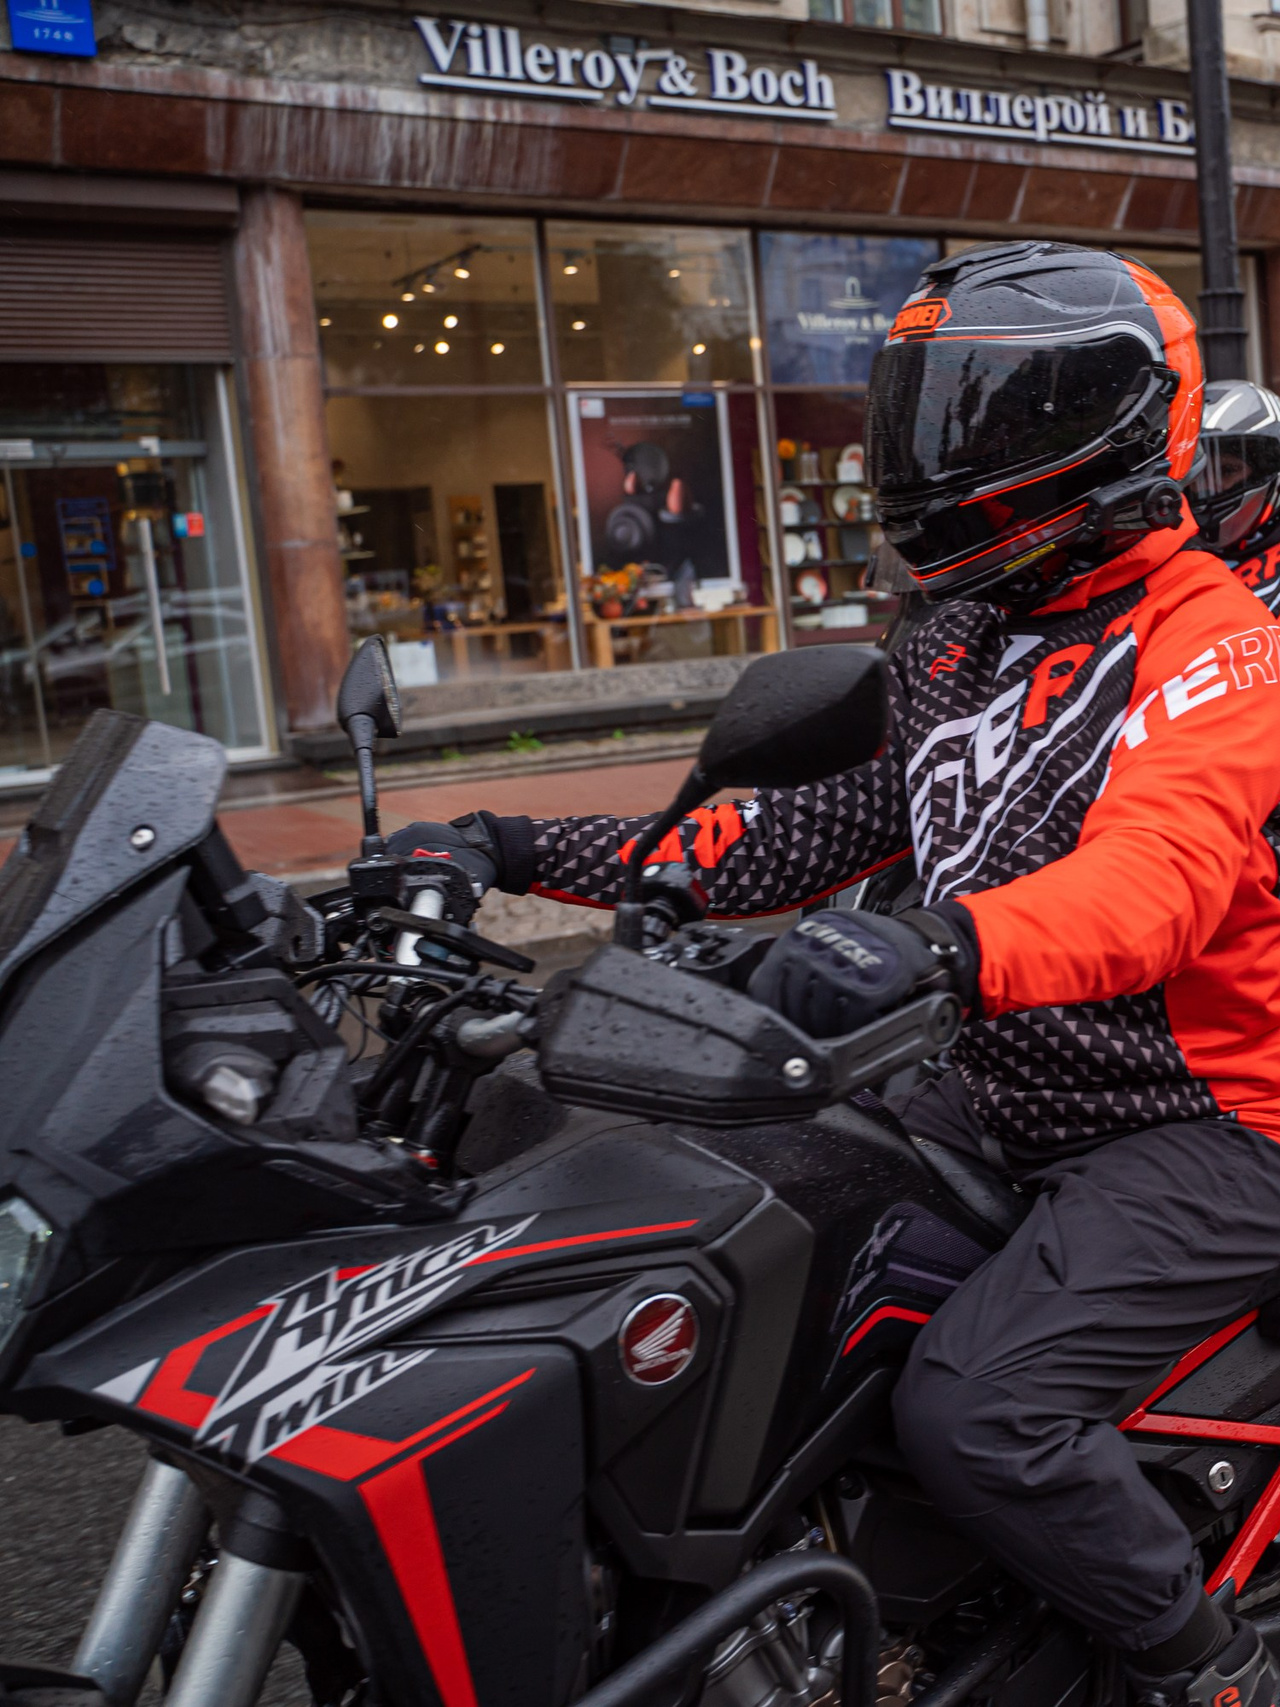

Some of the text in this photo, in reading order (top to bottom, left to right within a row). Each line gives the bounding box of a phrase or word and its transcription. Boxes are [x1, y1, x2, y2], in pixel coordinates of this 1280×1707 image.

[413, 16, 838, 110] Villeroy & Boch
[885, 68, 1112, 142] Виллерой
[1119, 105, 1149, 139] и
[632, 1347, 692, 1373] HONDA
